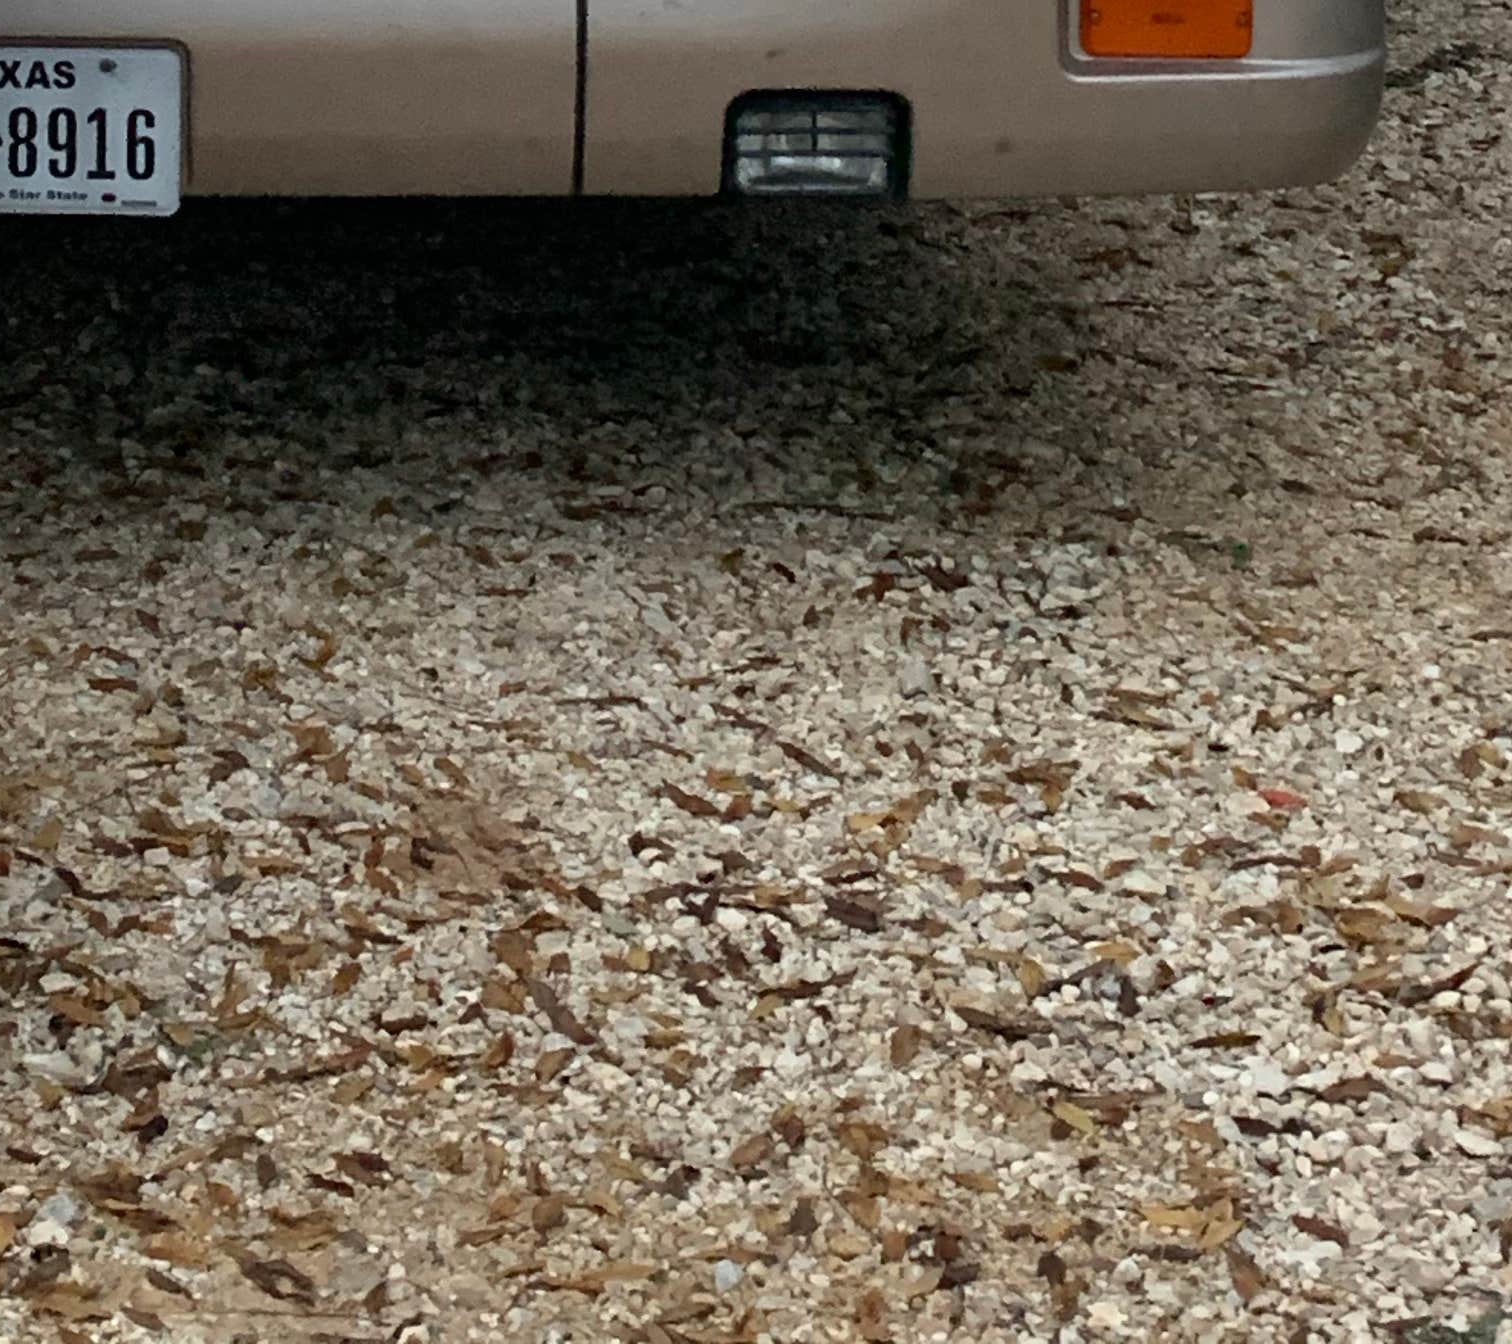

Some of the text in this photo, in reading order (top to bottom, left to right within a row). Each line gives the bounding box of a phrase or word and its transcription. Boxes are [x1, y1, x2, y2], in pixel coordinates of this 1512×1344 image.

[8, 107, 156, 180] 8916
[9, 189, 41, 200] Star
[47, 190, 88, 201] State
